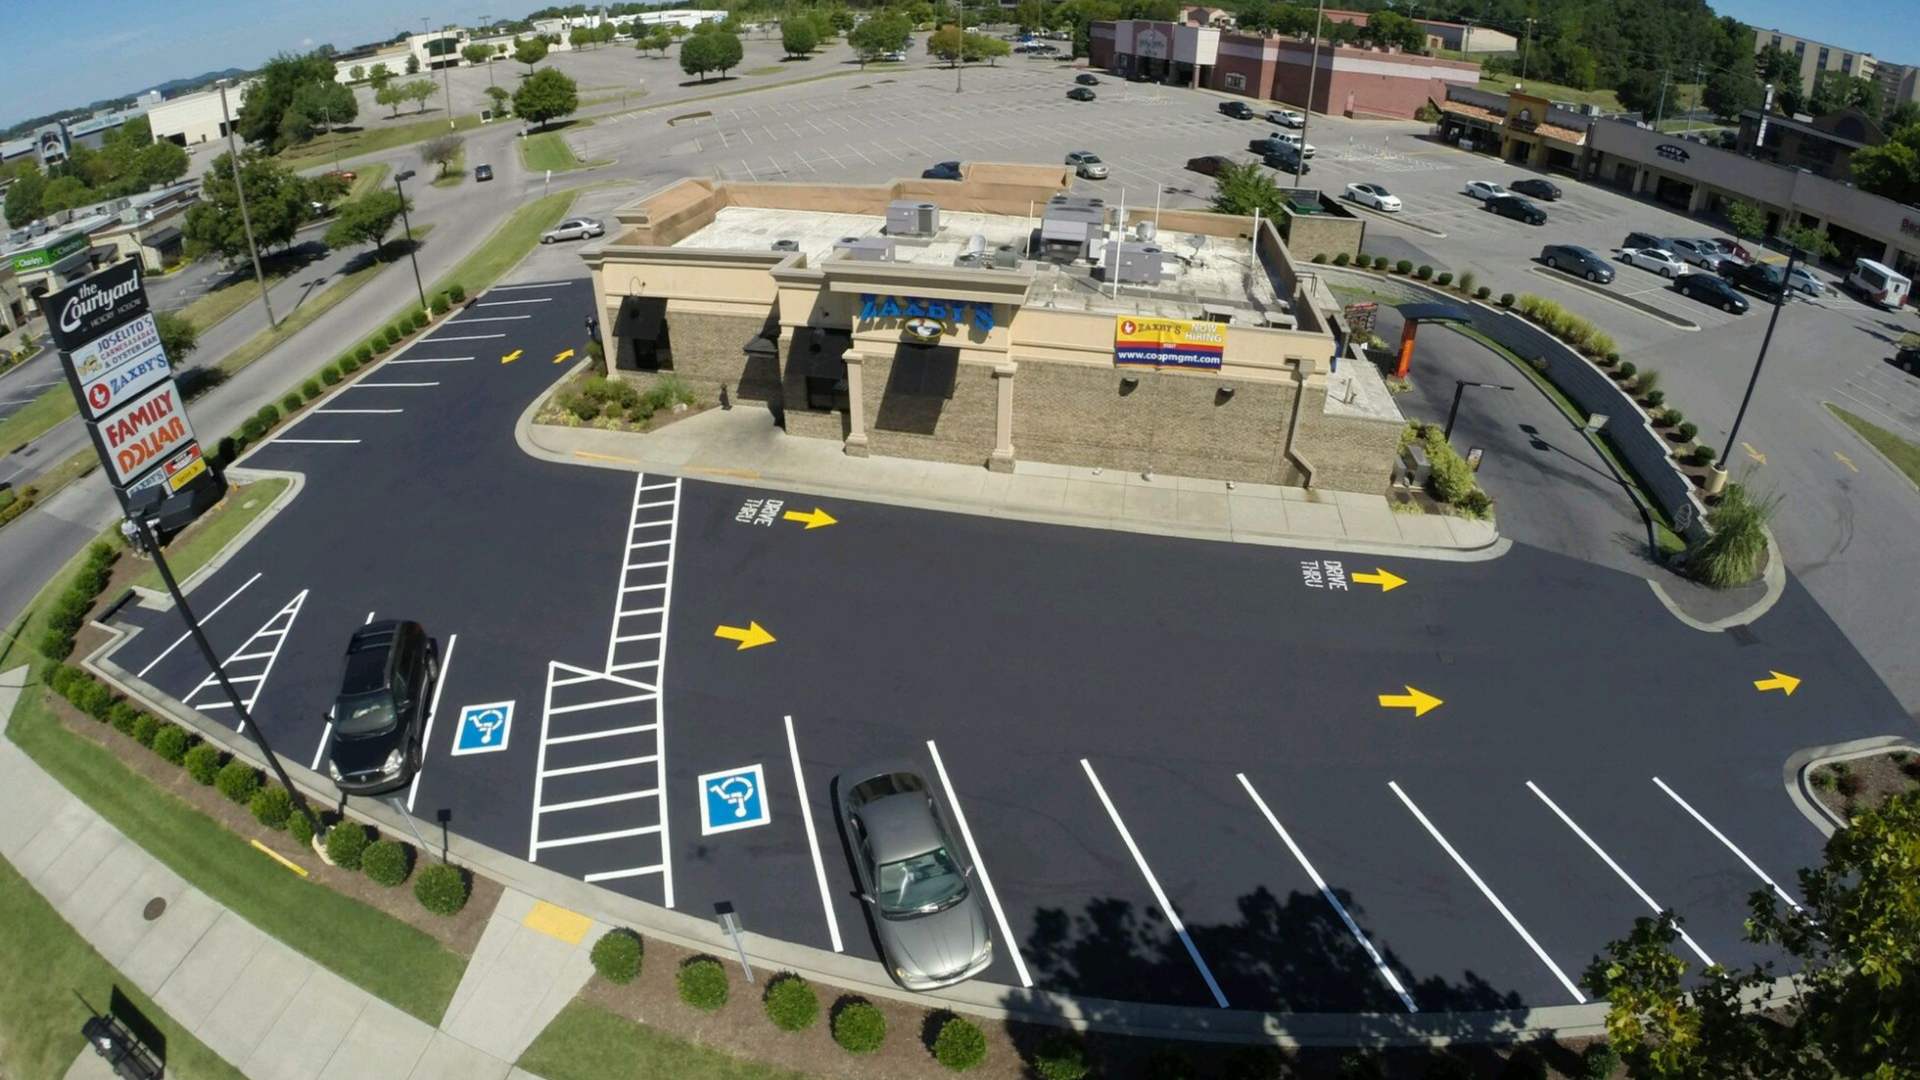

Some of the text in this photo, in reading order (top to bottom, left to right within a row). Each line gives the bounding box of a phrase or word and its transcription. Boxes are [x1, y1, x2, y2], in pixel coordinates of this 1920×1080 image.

[60, 269, 139, 333] Courtyard
[79, 283, 98, 299] the
[97, 316, 153, 353] JOSELITO'S
[1138, 323, 1218, 335] ZAXBY'S NOW
[1184, 332, 1222, 343] HIRING
[104, 335, 158, 369] & OYSTER BAR
[110, 353, 167, 396] ZAXBY'S
[105, 389, 174, 449] FAMILY
[116, 416, 186, 475] DOLLAR
[735, 499, 764, 523] THRU
[753, 499, 784, 527] DRIVE
[1300, 560, 1324, 588] THRU
[1323, 560, 1348, 591] DRIVE
